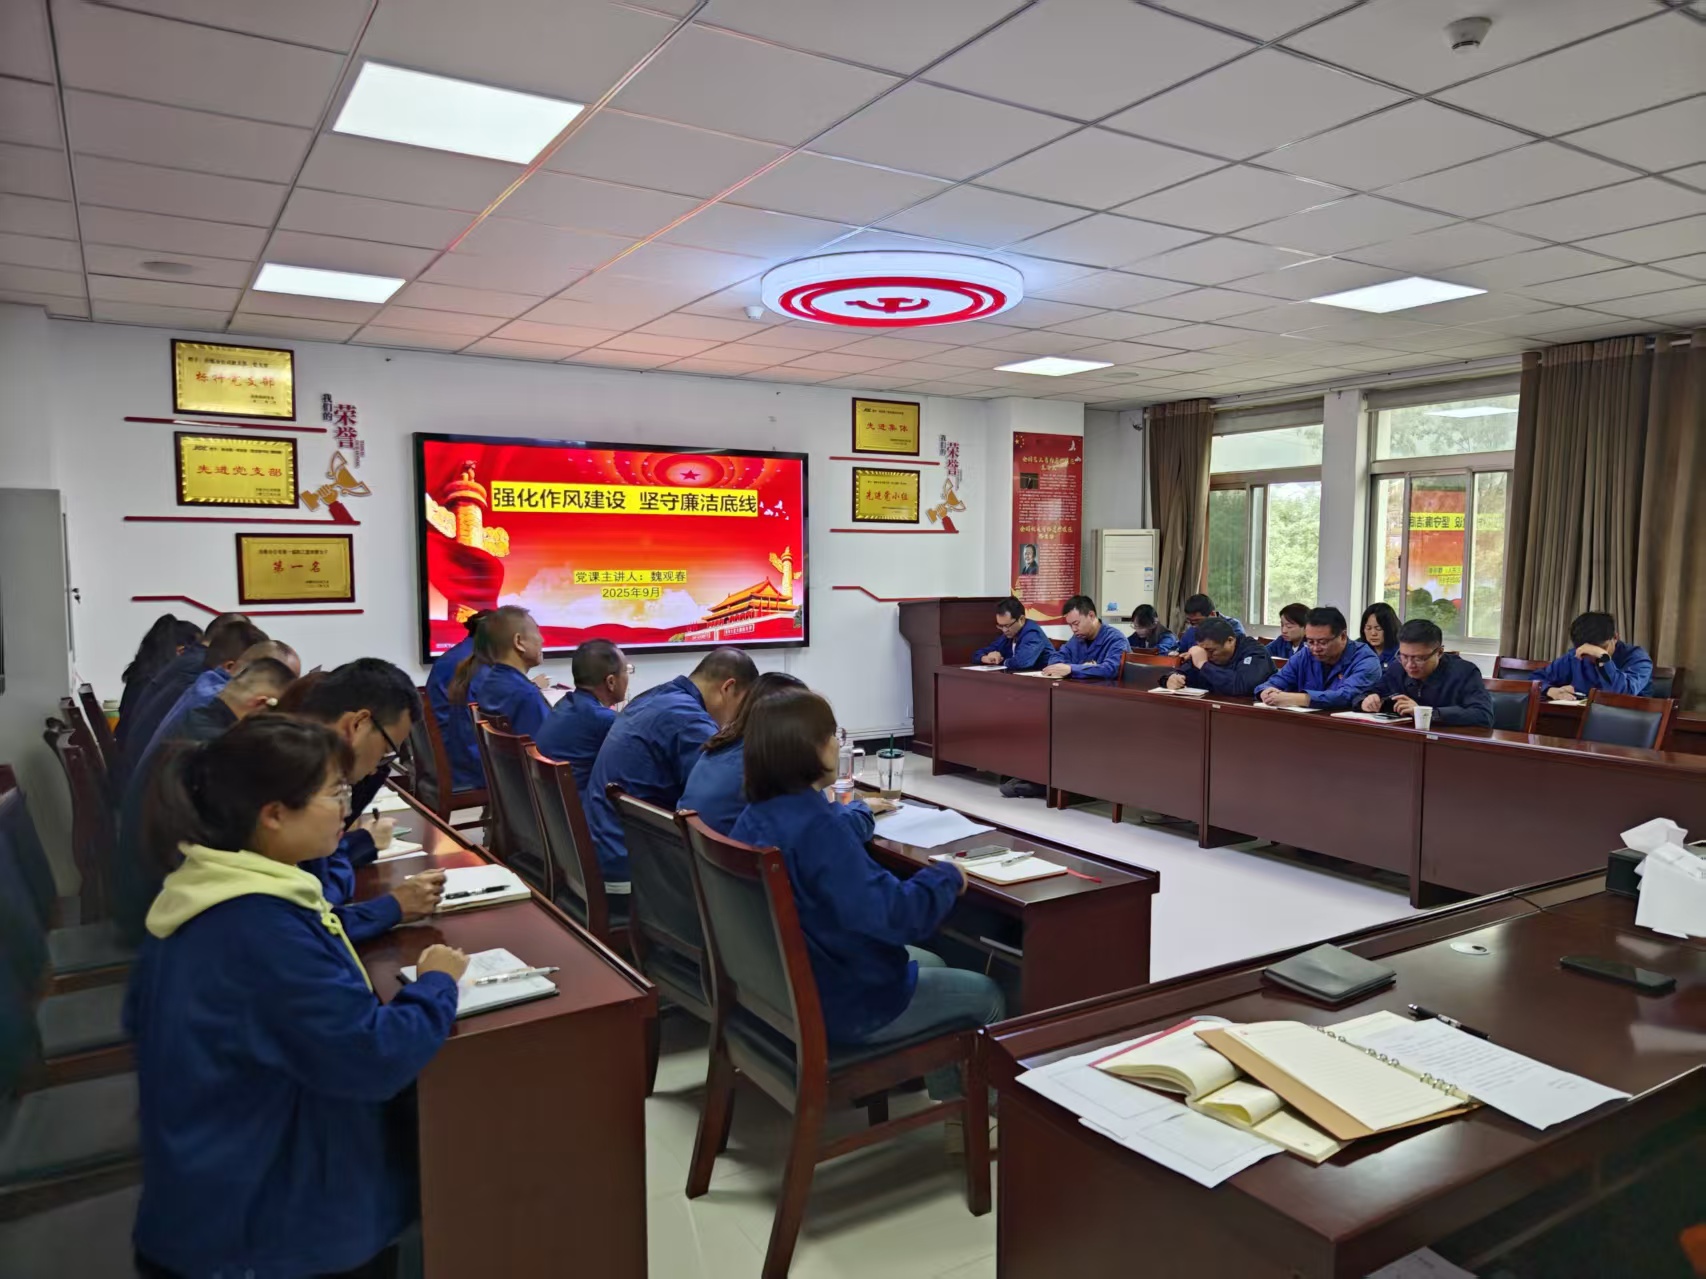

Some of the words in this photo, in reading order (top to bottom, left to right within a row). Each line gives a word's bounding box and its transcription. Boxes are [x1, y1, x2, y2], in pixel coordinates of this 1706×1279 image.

[333, 404, 357, 448] 荣誉
[196, 464, 282, 477] 先进党支部
[493, 487, 626, 510] 强化作风建设
[639, 491, 757, 514] 坚守廉洁底线
[272, 560, 320, 574] 第一名
[602, 586, 661, 598] 2025年9月
